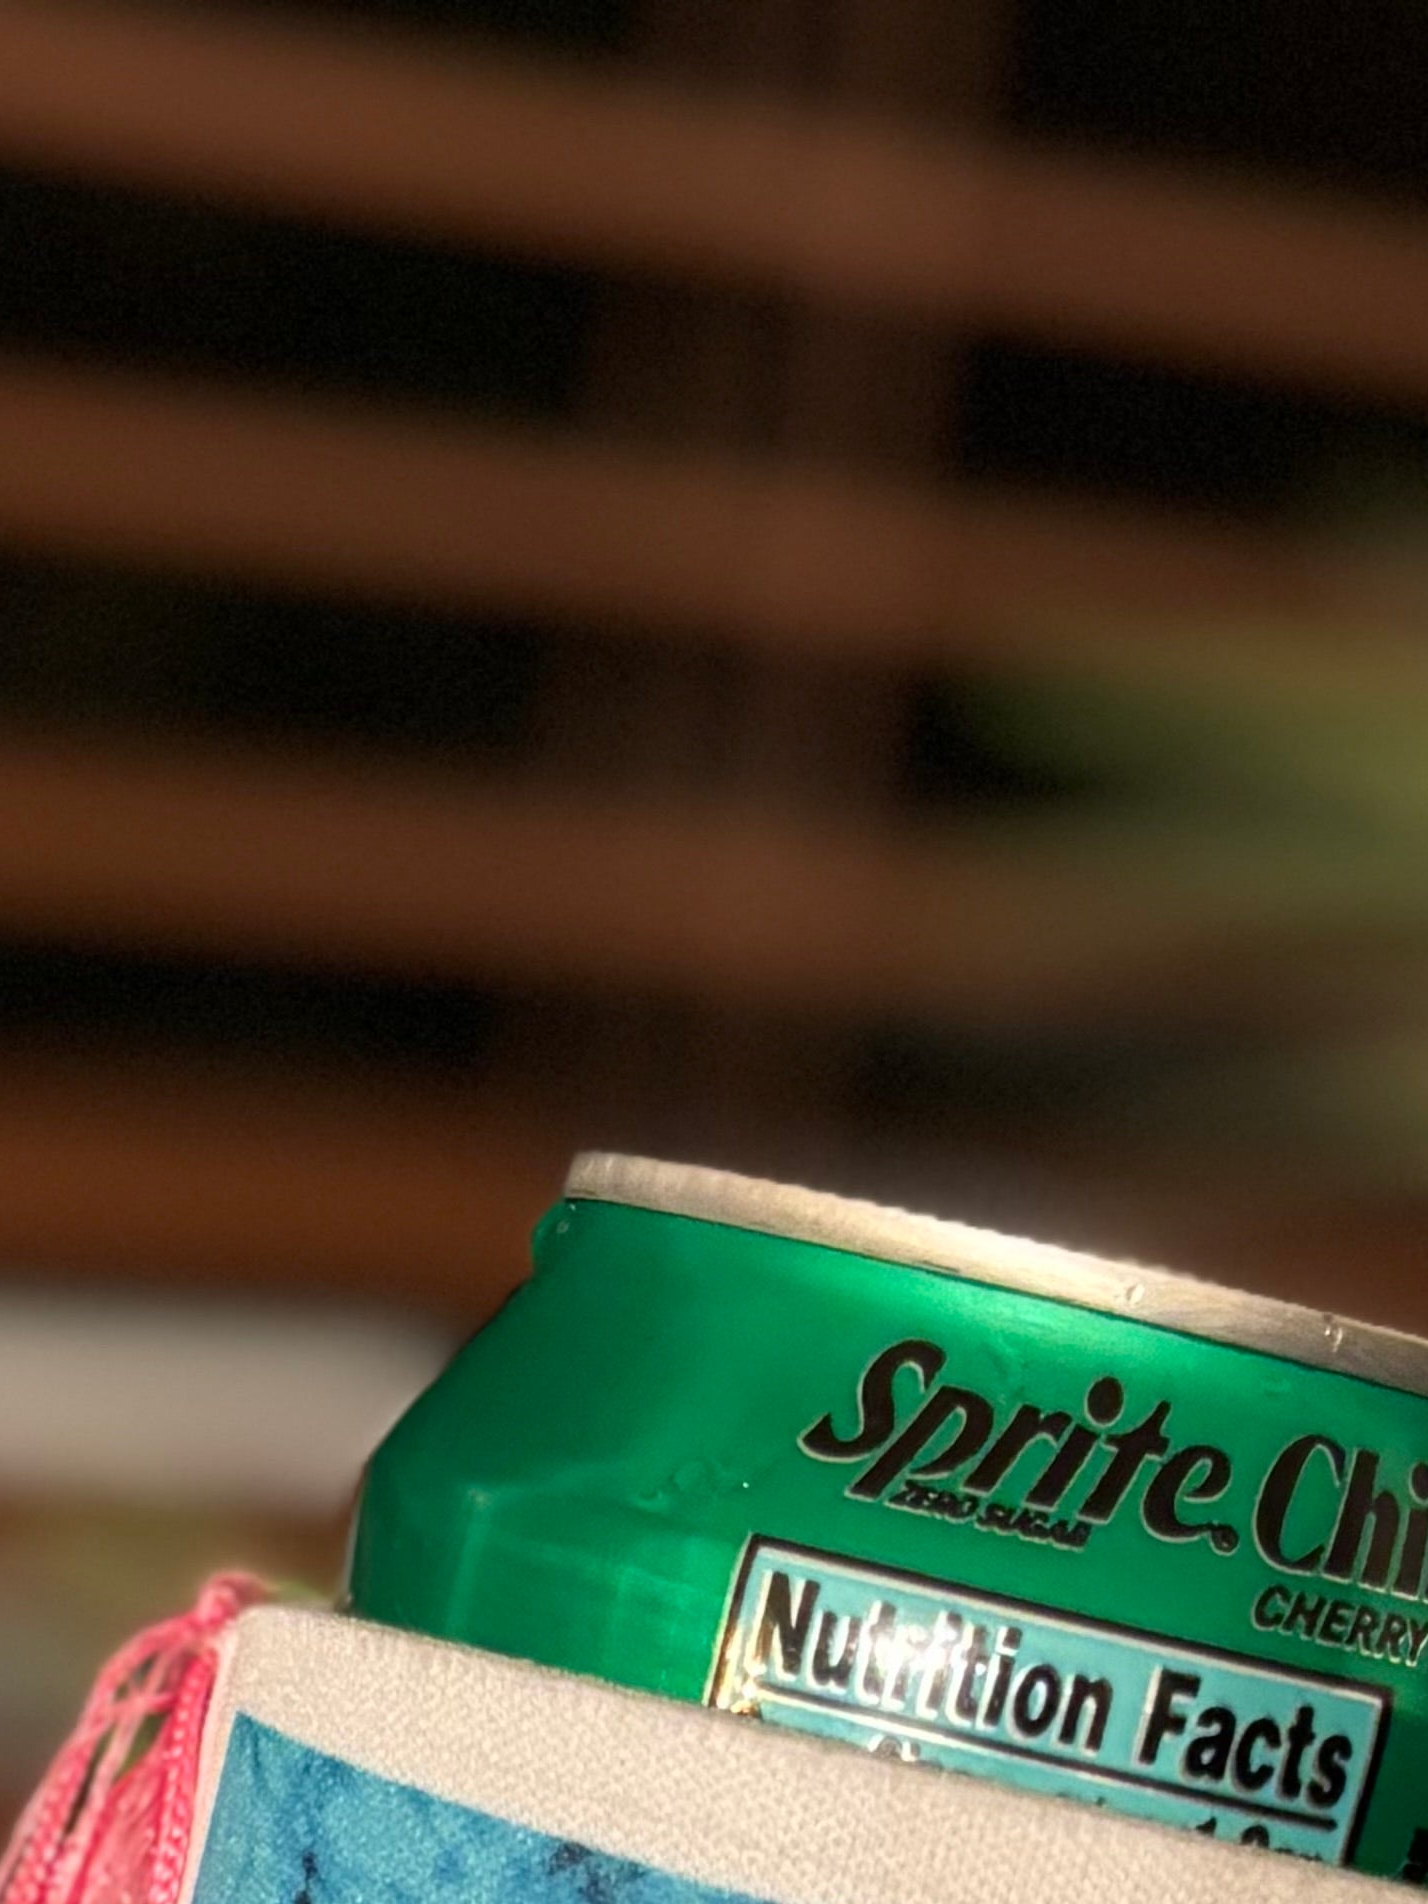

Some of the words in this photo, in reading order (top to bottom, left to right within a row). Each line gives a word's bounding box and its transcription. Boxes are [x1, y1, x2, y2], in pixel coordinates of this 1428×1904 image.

[797, 1338, 1234, 1545] Sprite
[750, 1570, 1114, 1757] Nutrition
[1135, 1664, 1355, 1811] Facts
